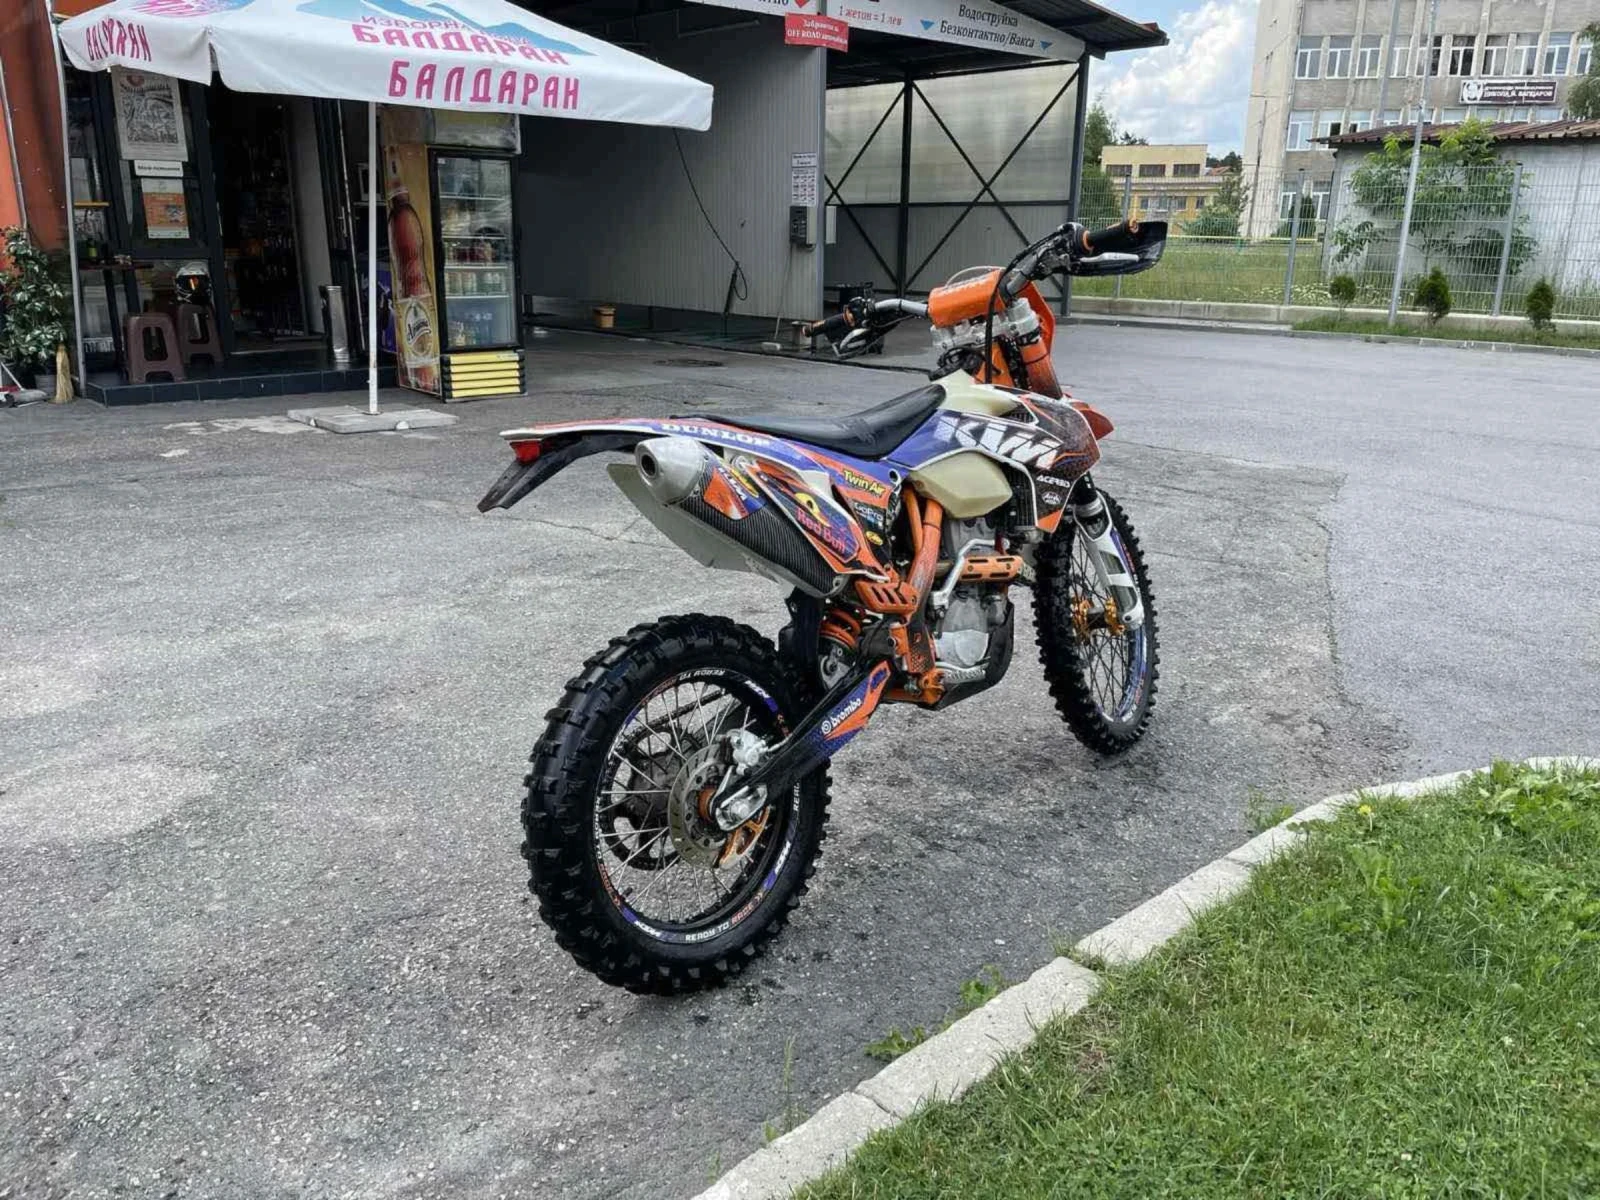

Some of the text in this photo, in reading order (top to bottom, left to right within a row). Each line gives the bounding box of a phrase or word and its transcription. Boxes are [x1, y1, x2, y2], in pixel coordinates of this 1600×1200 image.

[844, 9, 872, 21] жетон
[888, 15, 902, 26] лев
[958, 4, 1018, 27] Водоструйка
[352, 23, 571, 66] БАЛДАРАН
[787, 29, 801, 38] OFF
[801, 30, 821, 39] ROAD
[388, 60, 580, 110] БАЛДАРАН
[843, 470, 885, 497] Twin Air
[797, 507, 821, 536] Red
[823, 526, 846, 553] Bull
[831, 697, 861, 728] brembo
[685, 901, 755, 941] READY TO RACE
